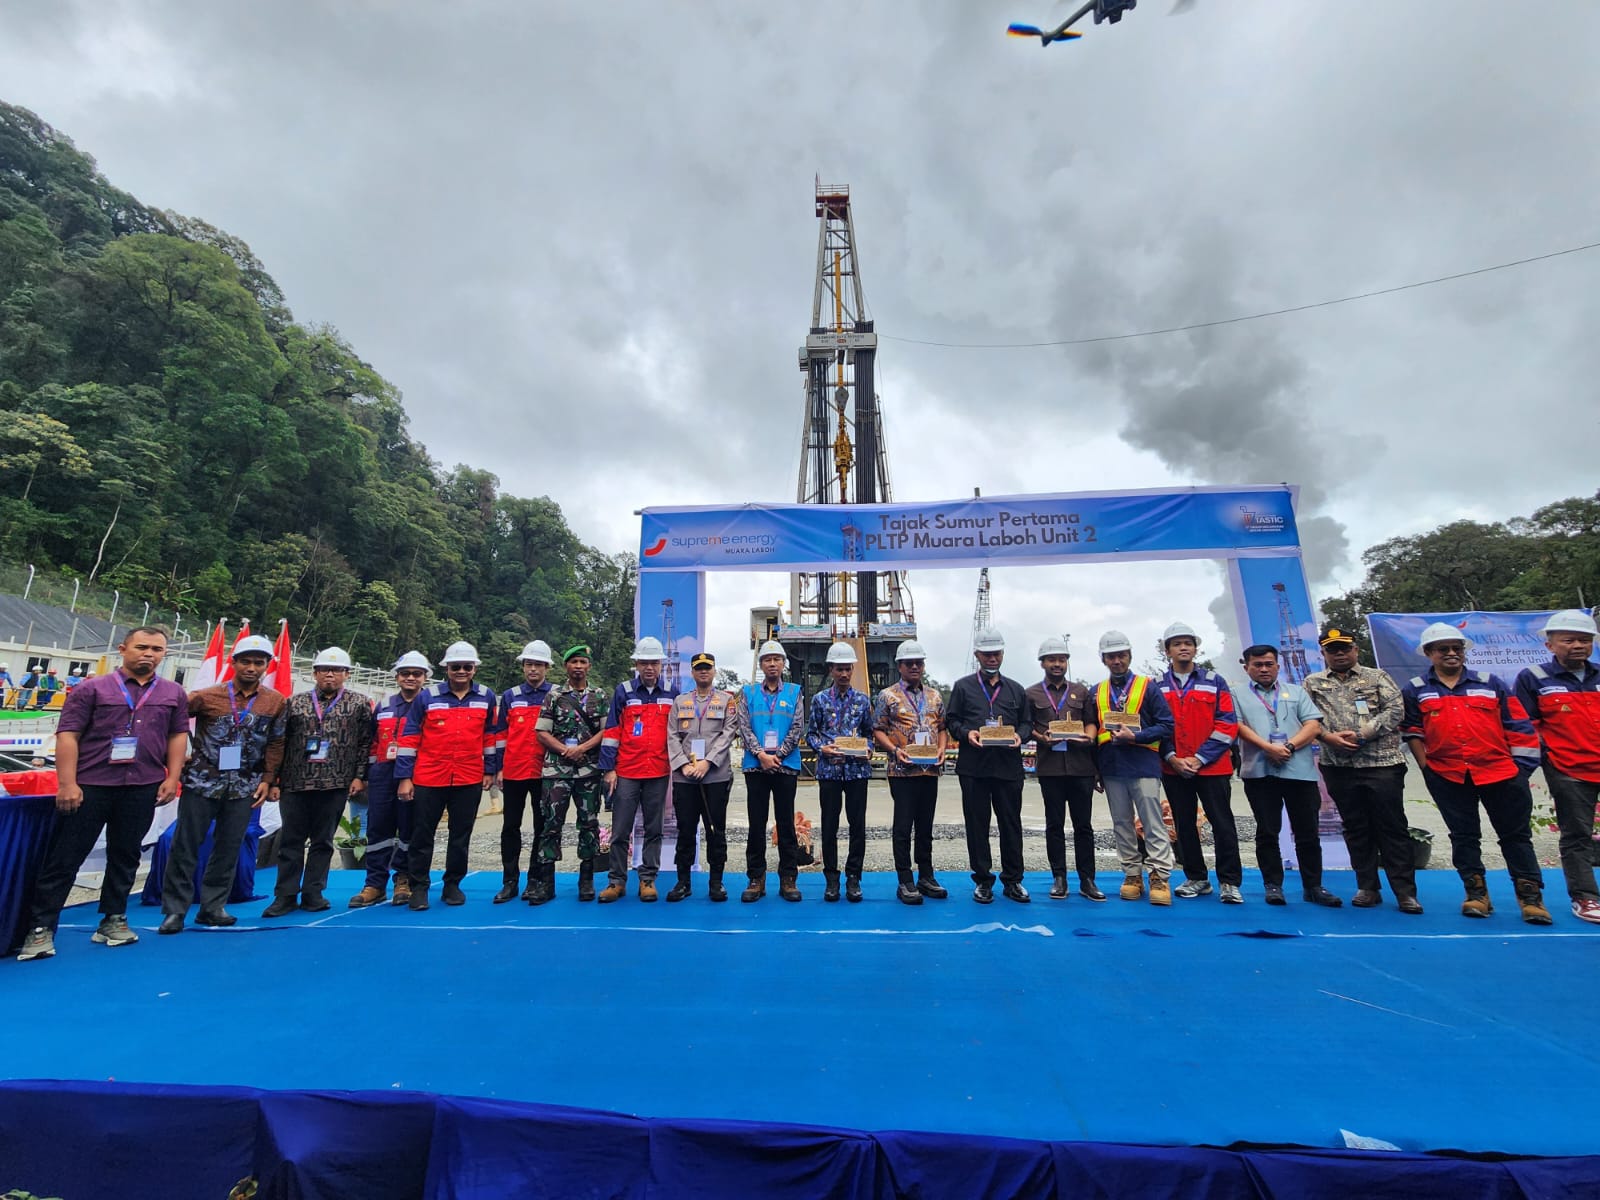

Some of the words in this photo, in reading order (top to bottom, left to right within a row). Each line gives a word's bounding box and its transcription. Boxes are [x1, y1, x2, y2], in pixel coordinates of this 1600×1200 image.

[879, 513, 930, 534] Tajak
[935, 513, 995, 529] Sumur
[999, 511, 1080, 527] Pertama
[672, 535, 730, 548] supreme
[731, 534, 777, 546] energy
[865, 533, 908, 550] PLTP
[913, 532, 974, 549] Muara
[979, 528, 1037, 546] Laboh
[1041, 527, 1079, 543] Unit
[1083, 525, 1097, 542] 2
[1471, 648, 1504, 657] Sumur
[1506, 648, 1547, 656] Pertama
[1495, 657, 1526, 665] Laboh
